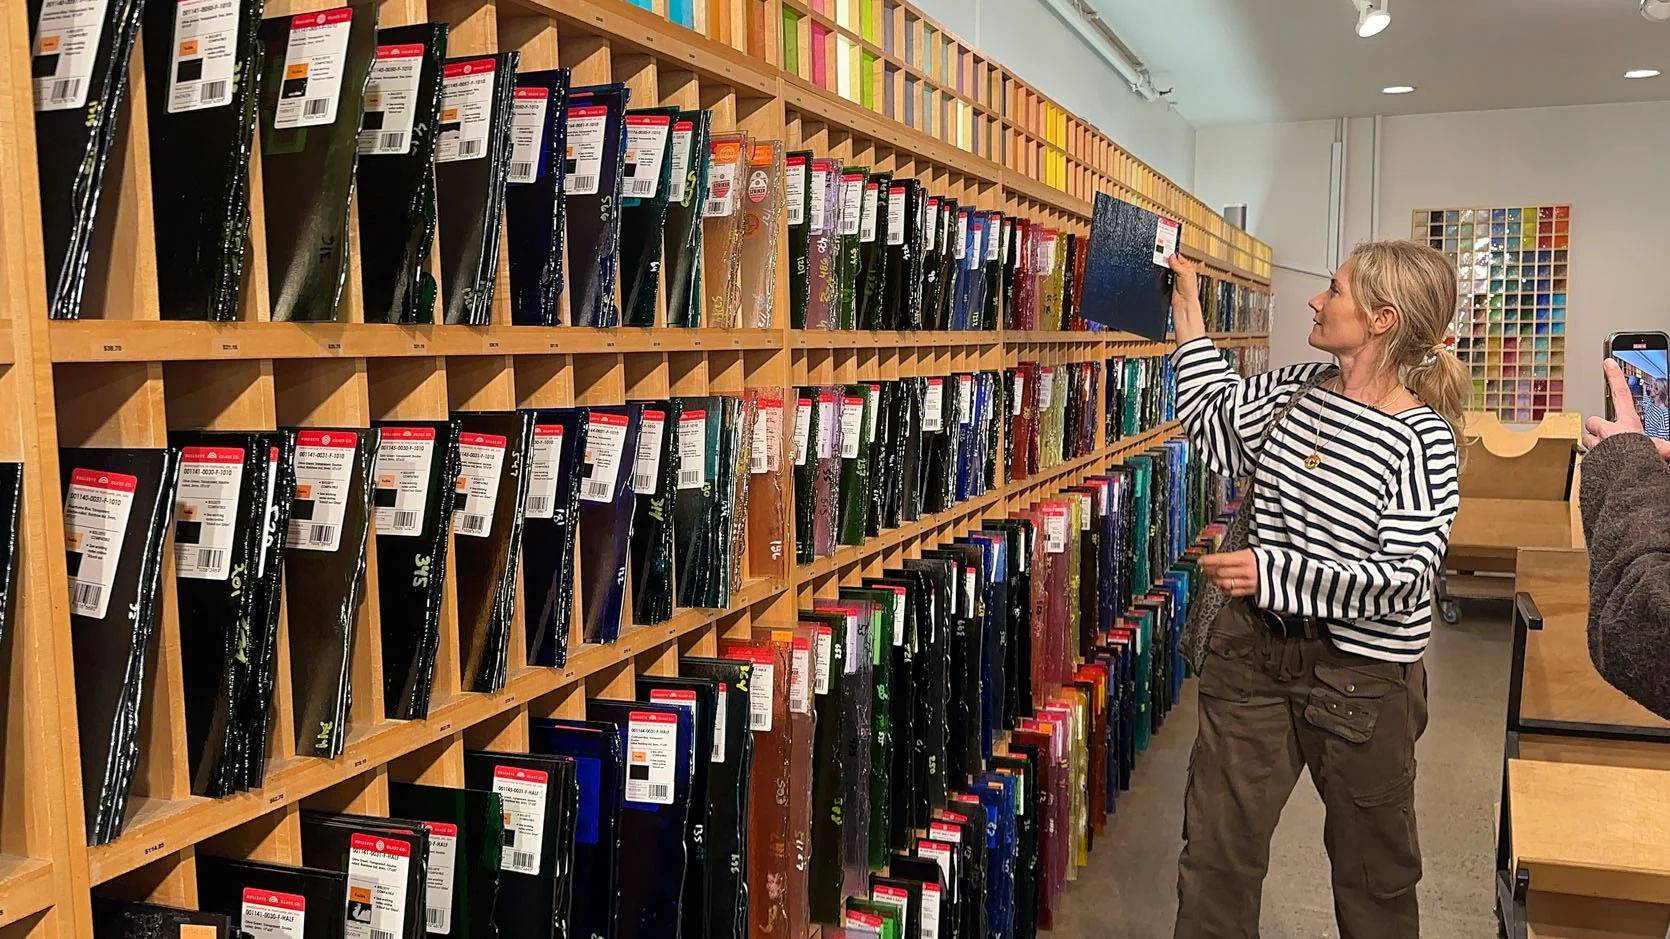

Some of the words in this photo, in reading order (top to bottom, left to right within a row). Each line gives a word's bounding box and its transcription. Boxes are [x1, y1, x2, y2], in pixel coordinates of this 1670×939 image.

[231, 563, 247, 597] 201
[412, 554, 430, 588] 345
[245, 909, 295, 922] 001141-0030-F-HALF
